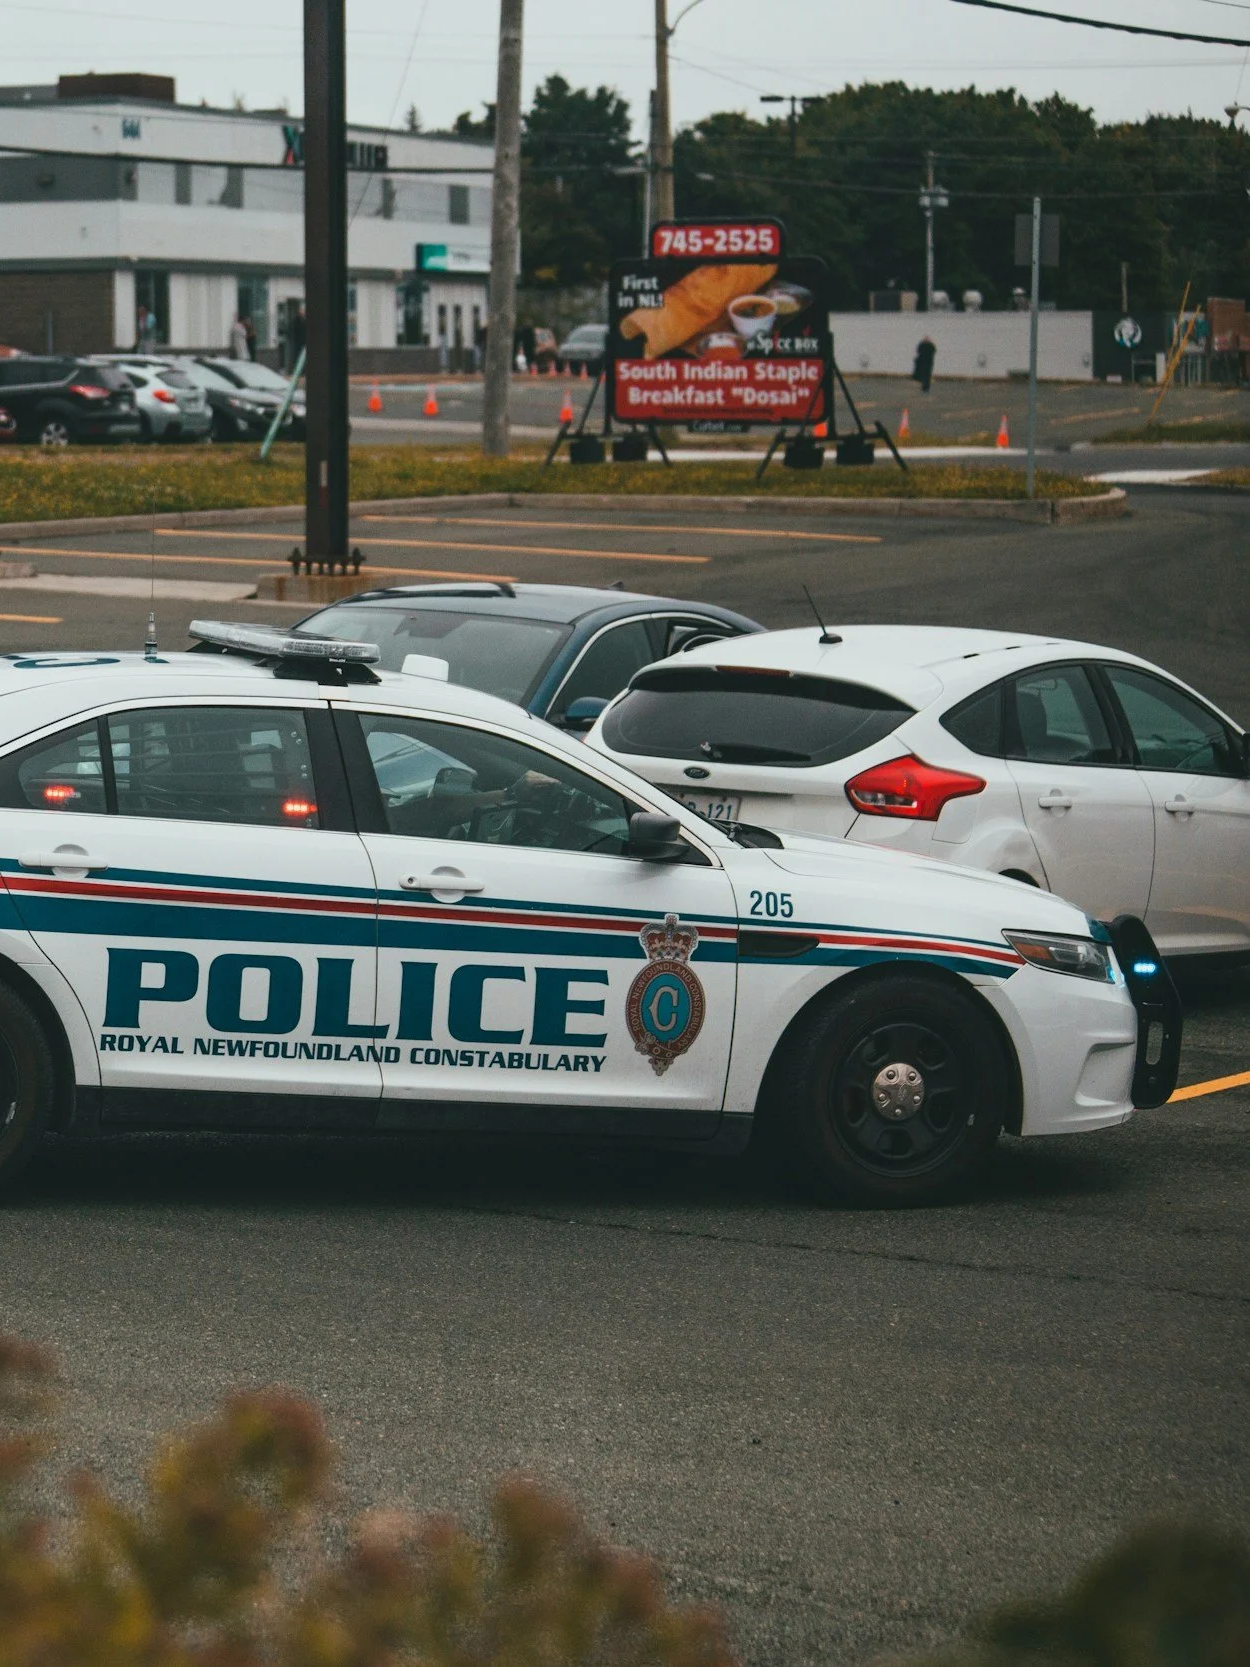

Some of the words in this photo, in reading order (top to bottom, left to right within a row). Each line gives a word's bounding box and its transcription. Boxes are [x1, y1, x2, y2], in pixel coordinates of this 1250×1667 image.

[660, 229, 773, 253] 745-2525
[623, 275, 659, 290] First
[618, 291, 634, 308] in
[619, 362, 677, 381] South
[683, 361, 748, 381] Indian
[754, 362, 818, 384] Staple
[628, 387, 725, 405] Breakfast
[749, 890, 793, 918] 205
[105, 947, 609, 1047] POLICE
[649, 986, 679, 1031] C
[100, 1033, 184, 1055] ROYAL
[192, 1038, 399, 1065] NEWFOUNDLAND
[409, 1048, 607, 1073] CONSTABULARY
